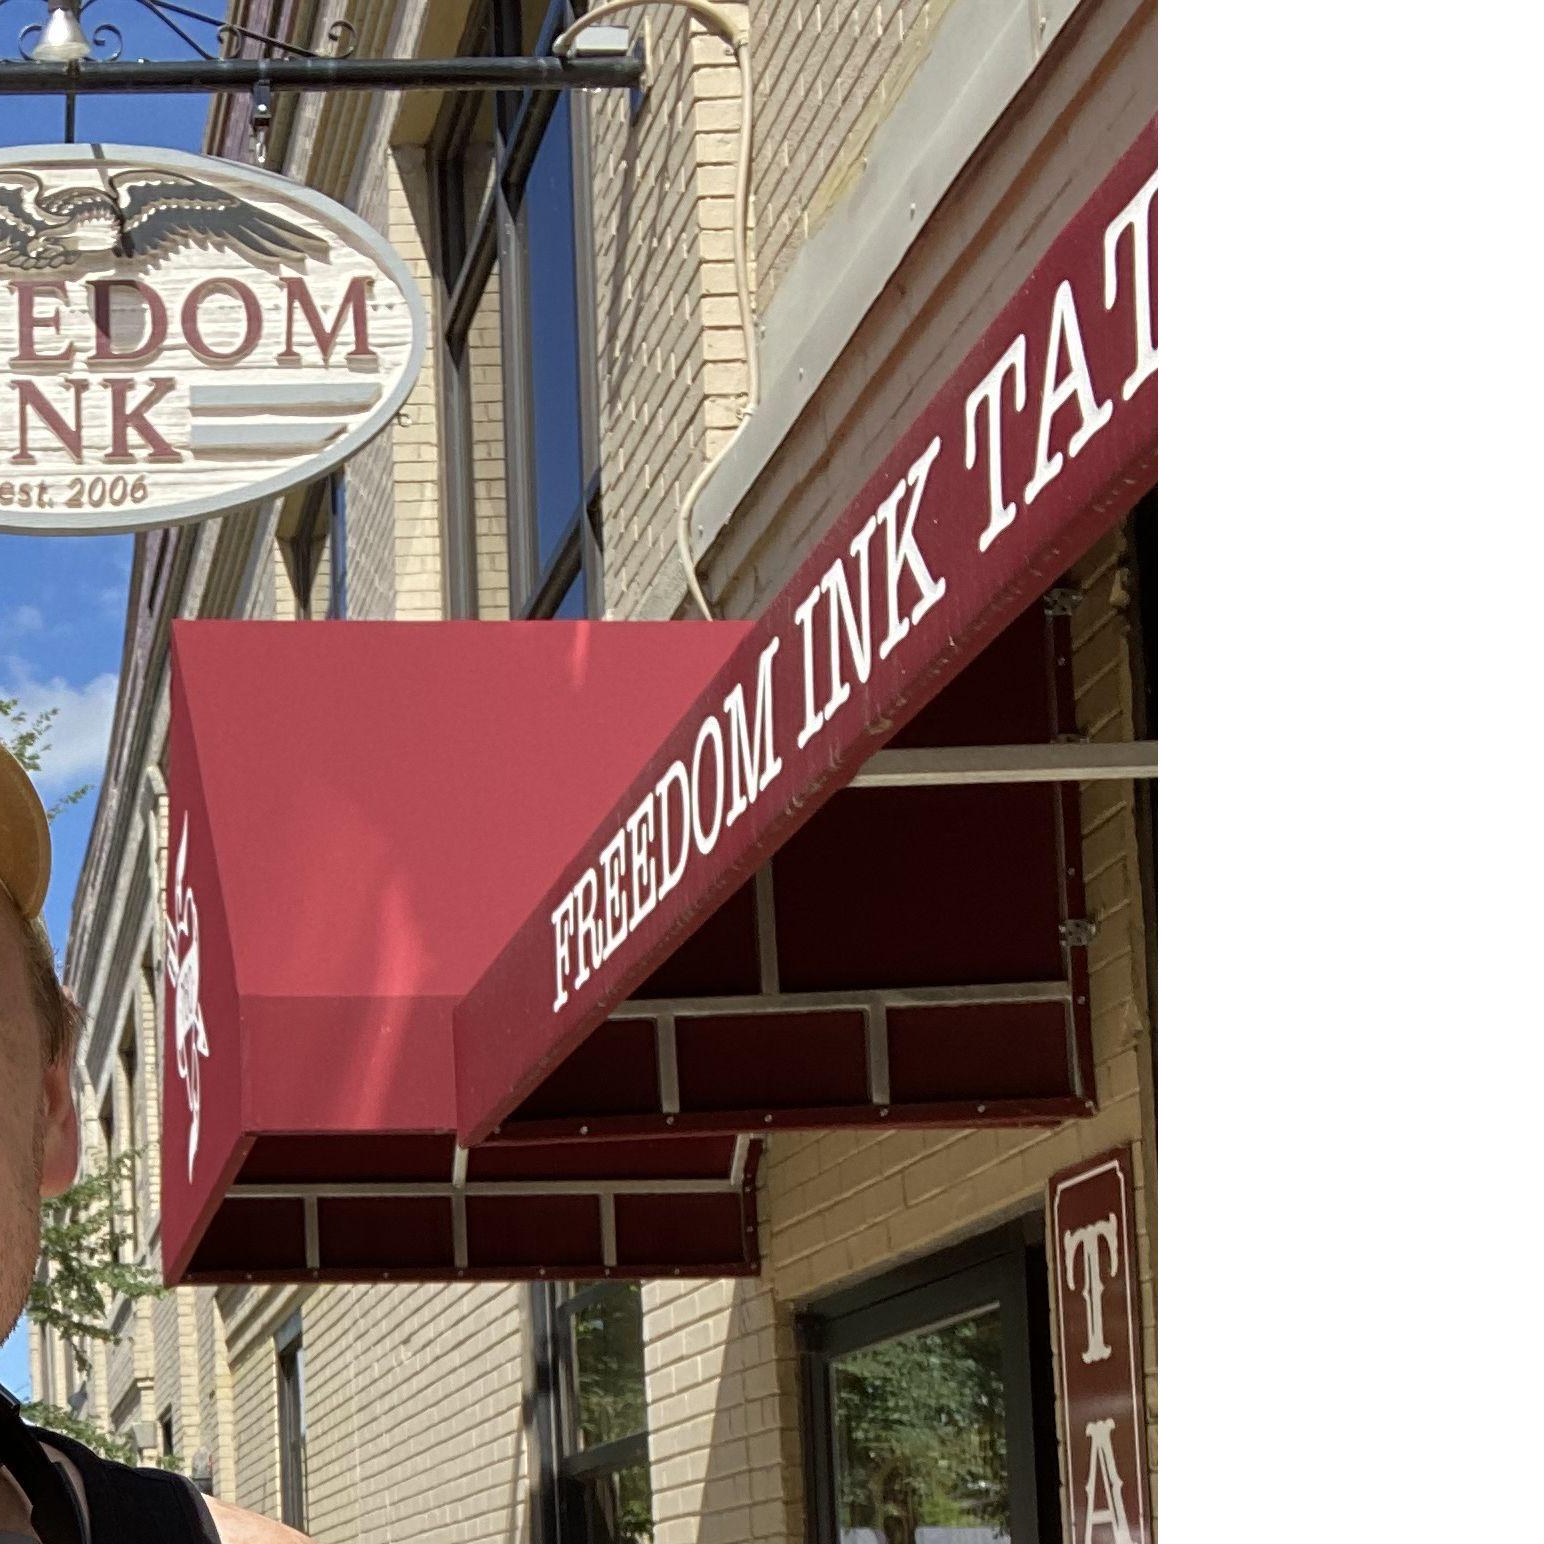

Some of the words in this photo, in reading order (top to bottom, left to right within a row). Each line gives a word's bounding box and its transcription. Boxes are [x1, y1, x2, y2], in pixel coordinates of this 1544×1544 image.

[64, 474, 149, 508] 2006
[552, 636, 782, 1013] FREEDOM
[795, 436, 946, 749] INK
